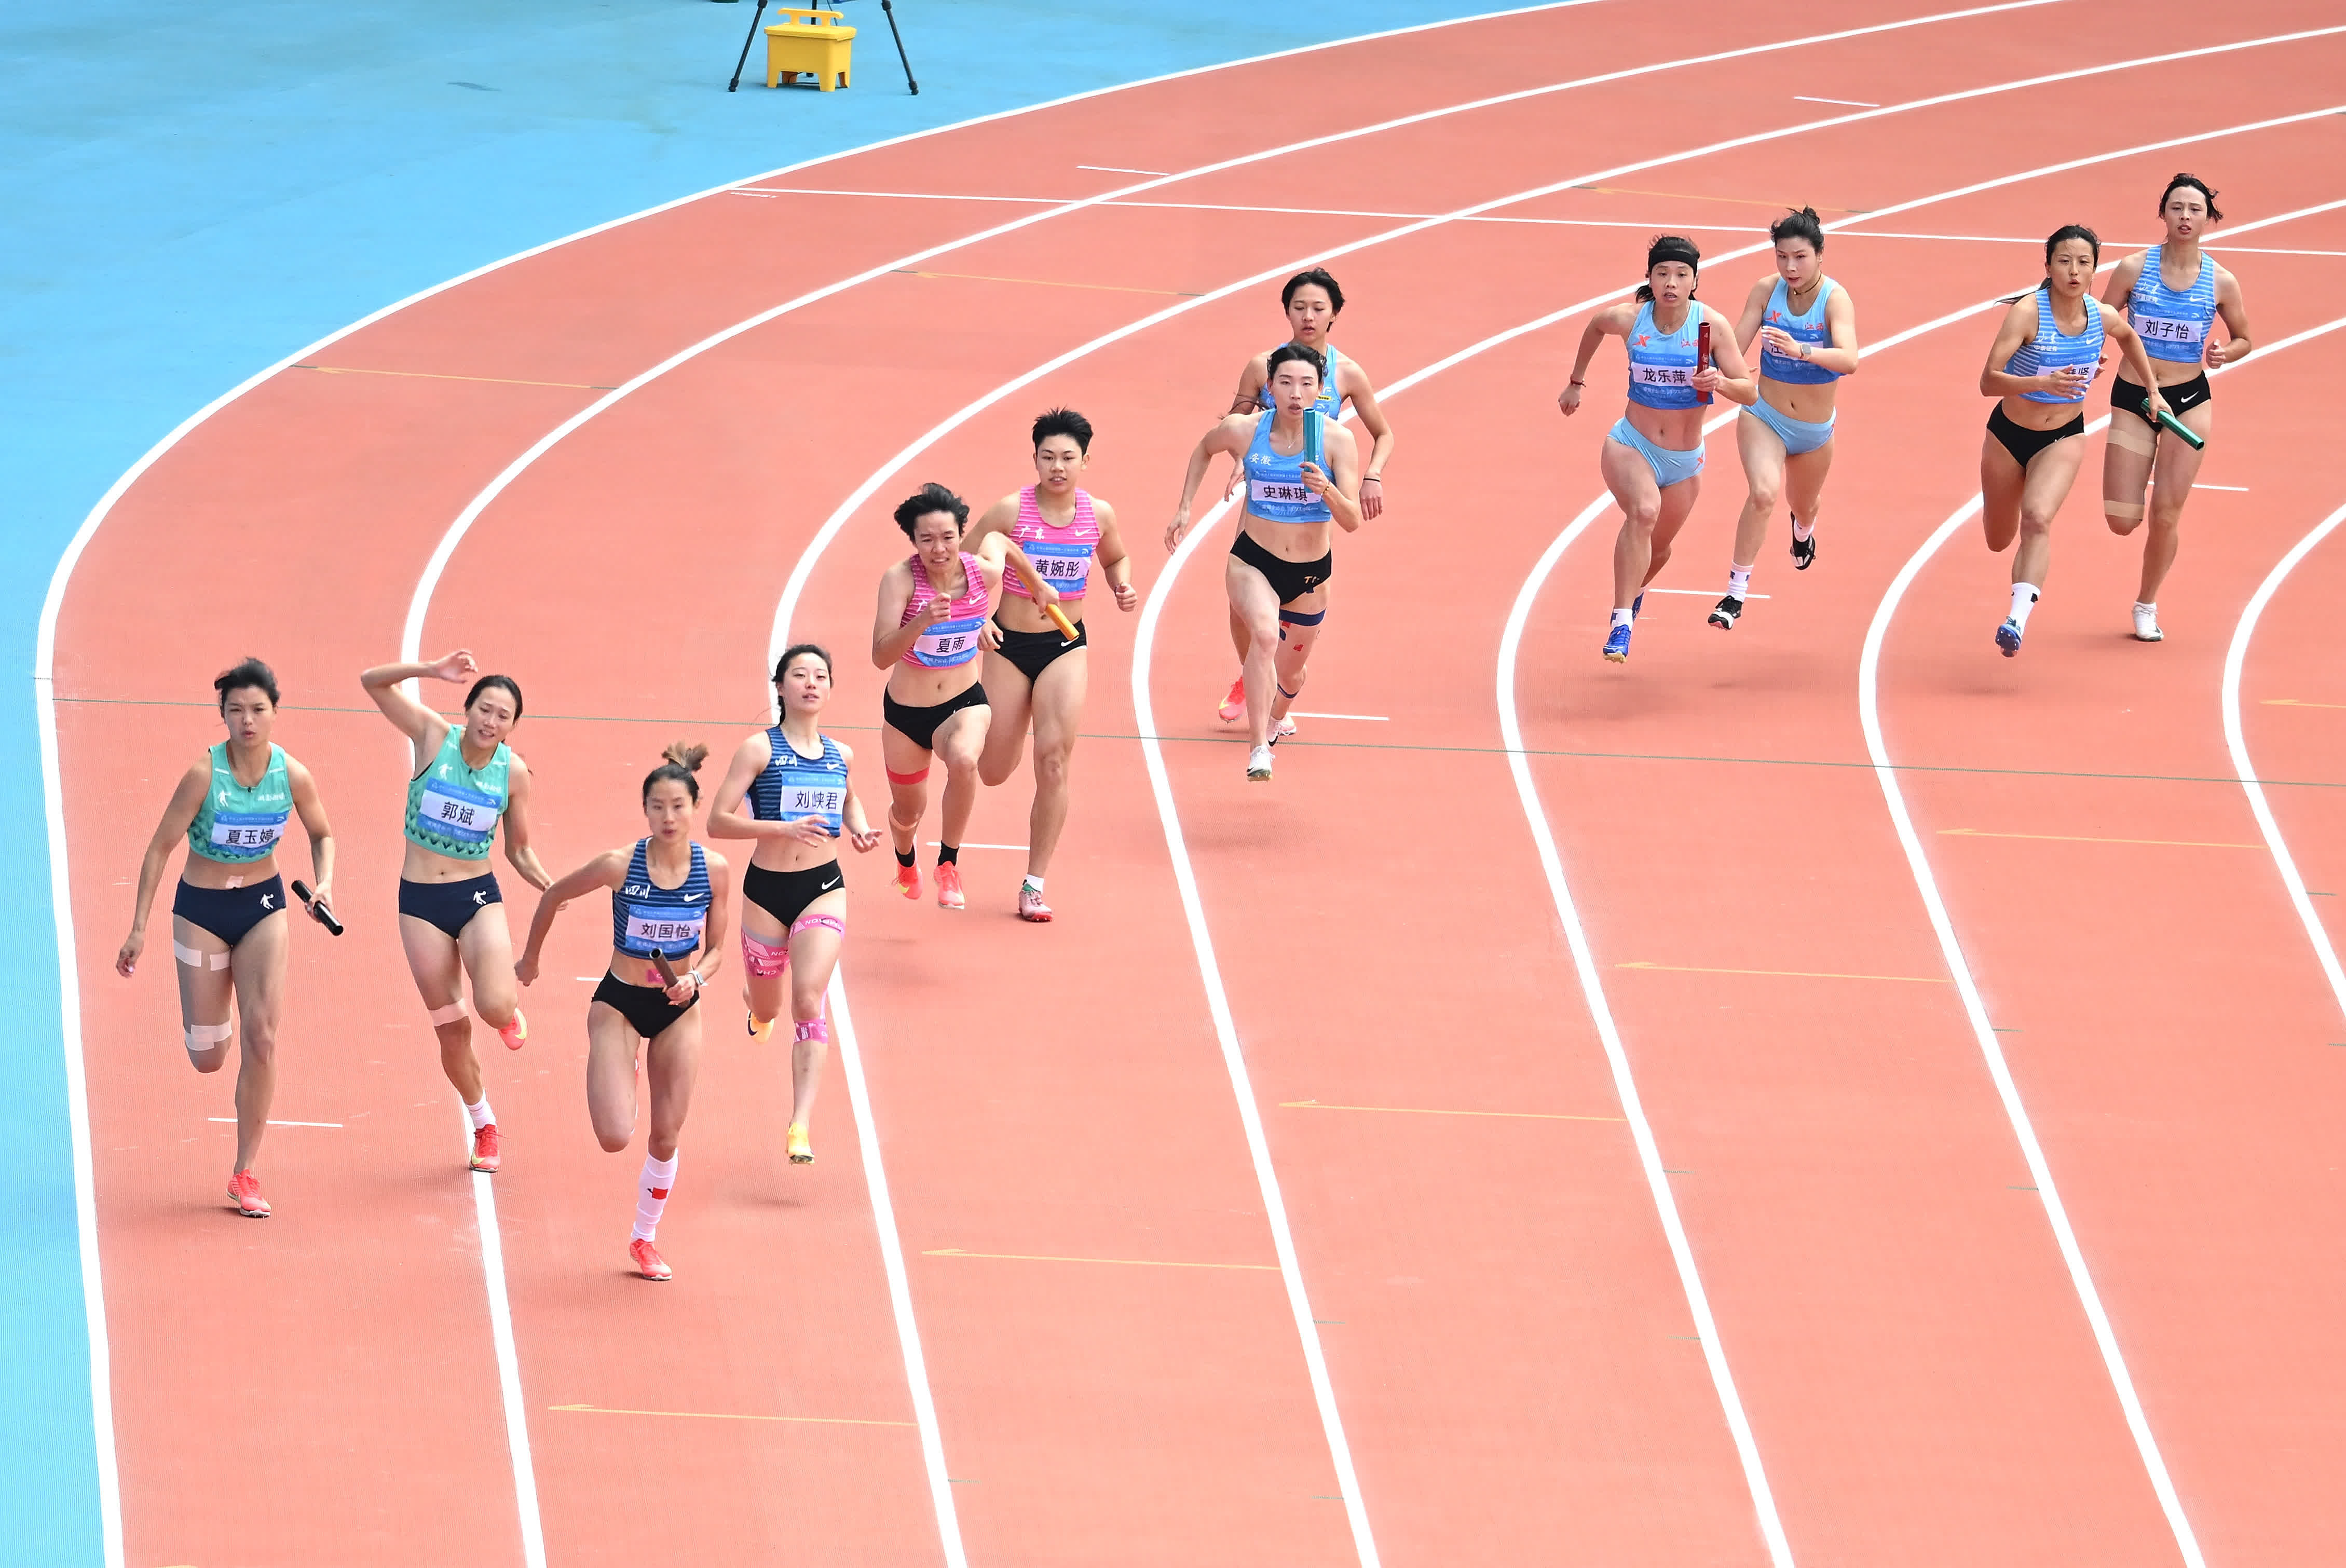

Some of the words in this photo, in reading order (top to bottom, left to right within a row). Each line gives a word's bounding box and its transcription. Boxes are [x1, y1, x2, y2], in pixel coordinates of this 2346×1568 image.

[2144, 319, 2189, 339] 刘子怡
[1642, 367, 1686, 384] 龙乐萍
[1249, 453, 1271, 466] 安徽
[1263, 485, 1308, 501] 史琳琪
[1035, 558, 1080, 577] 黄婉彤
[936, 636, 966, 653] 夏雨
[795, 790, 838, 810] 刘峡君
[441, 801, 475, 826] 郭斌
[225, 829, 275, 845] 夏玉婷
[624, 884, 651, 899] 四川
[640, 922, 691, 938] 刘国怡
